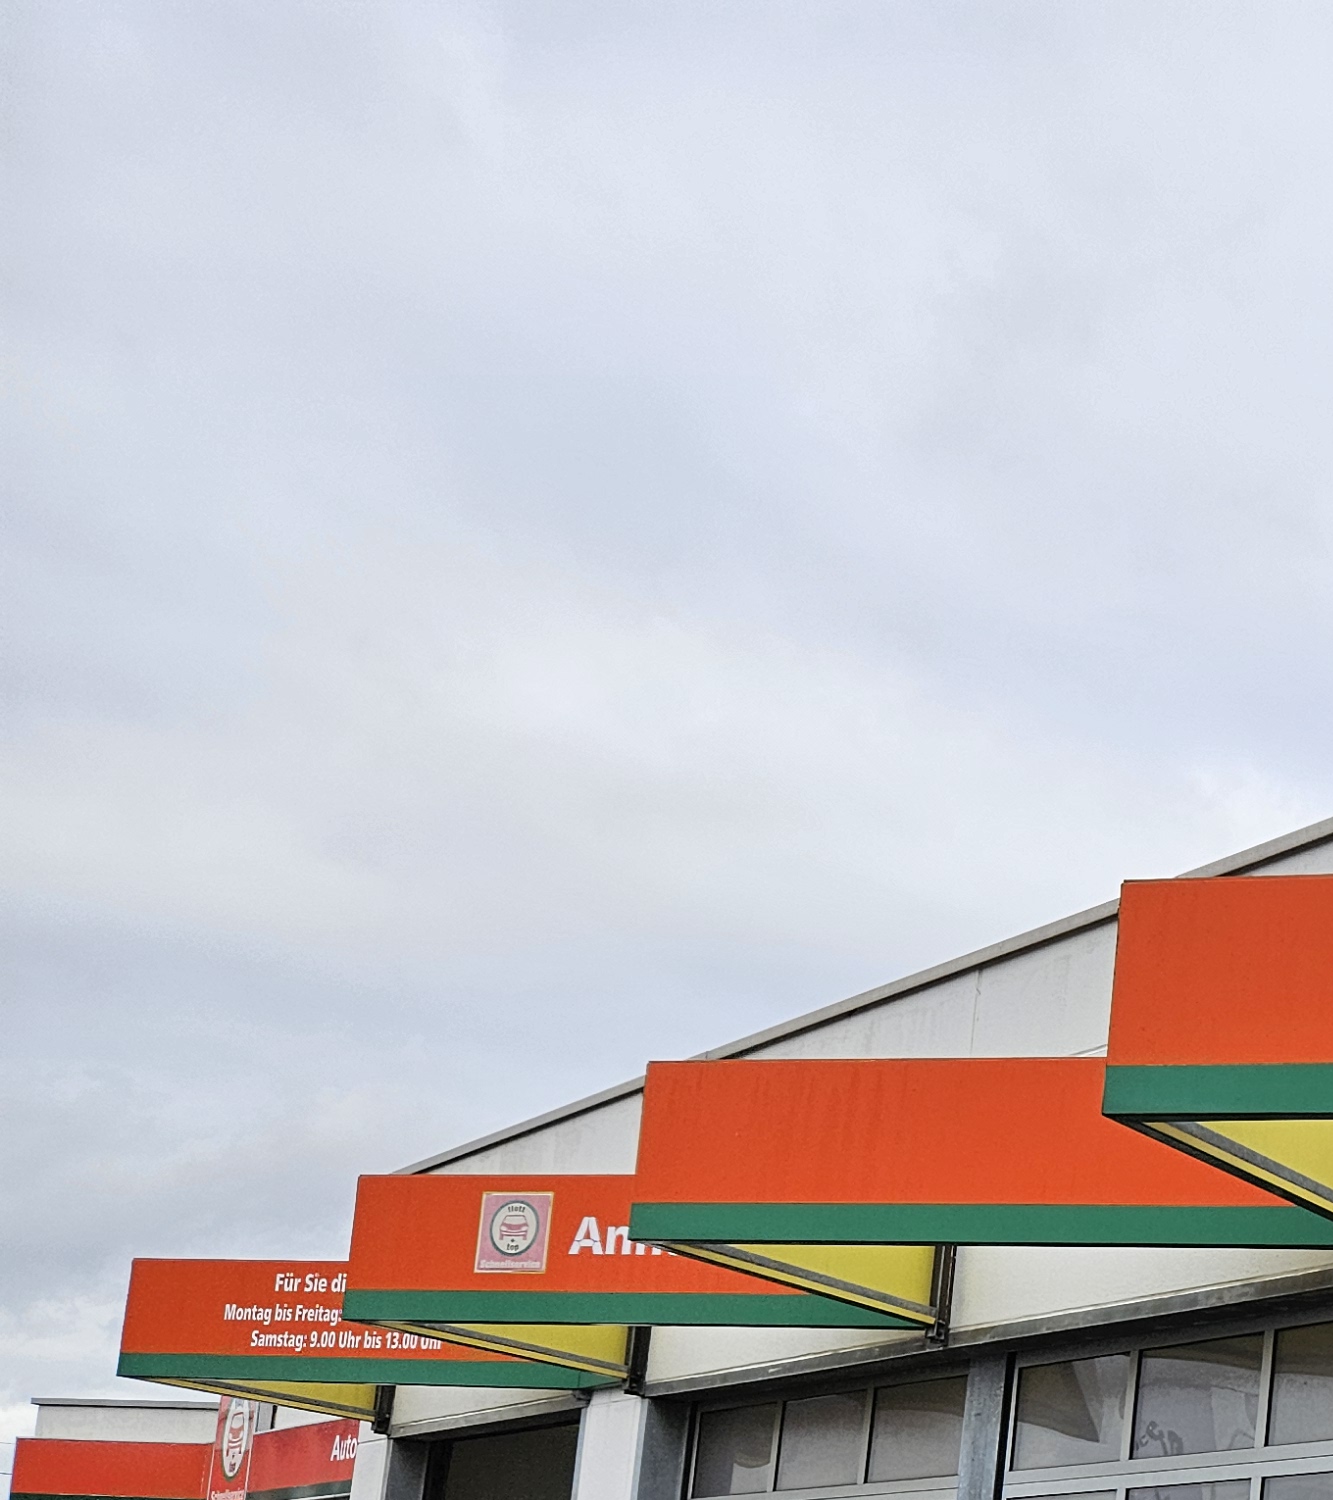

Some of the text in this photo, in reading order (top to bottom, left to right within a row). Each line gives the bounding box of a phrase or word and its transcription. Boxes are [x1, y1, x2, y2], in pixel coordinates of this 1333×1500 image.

[274, 1272, 302, 1292] Für
[304, 1272, 328, 1293] Sie
[223, 1303, 343, 1327] Montag bis Freitag:
[250, 1329, 307, 1352] Samstag:
[309, 1330, 336, 1348] 9.00
[338, 1330, 362, 1349] Uhr
[363, 1330, 383, 1349] bis
[385, 1331, 418, 1350] 13.00
[330, 1434, 358, 1462] Auto
